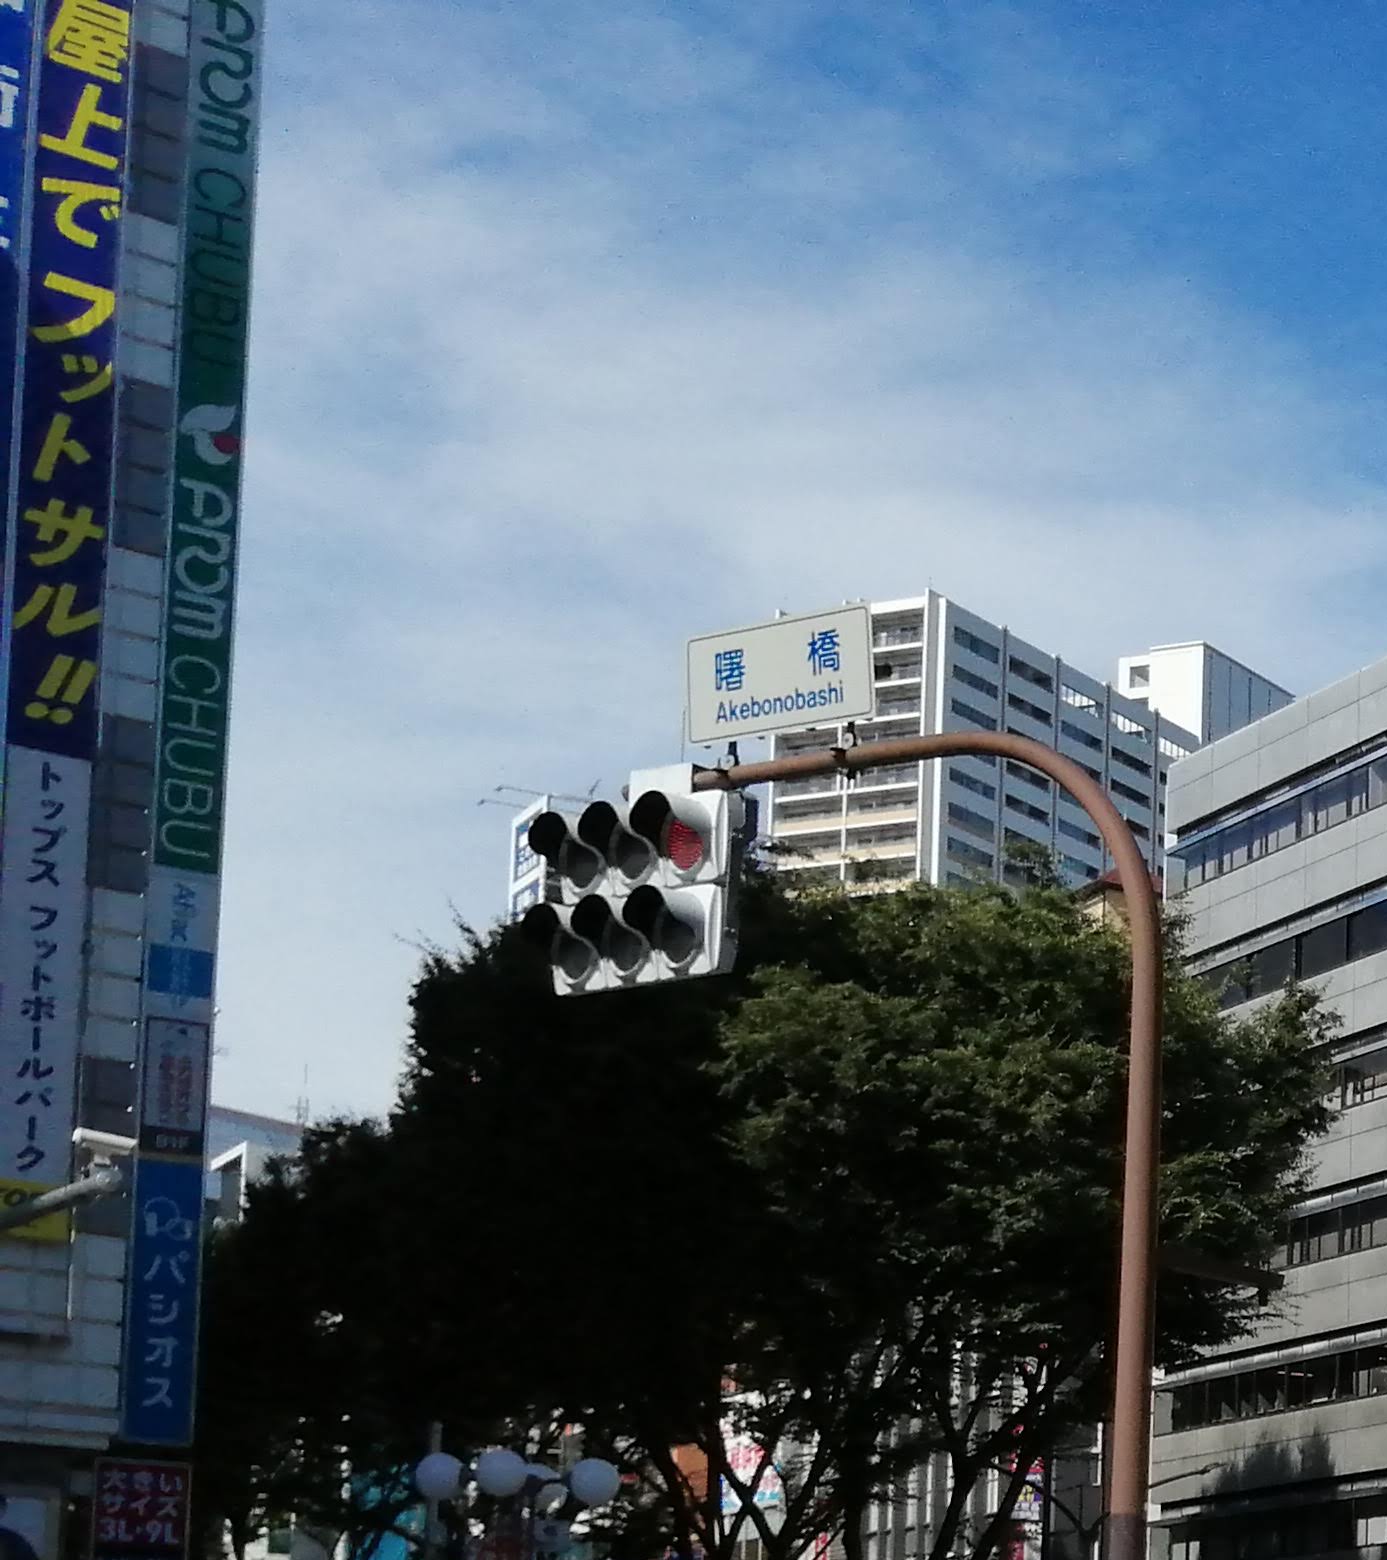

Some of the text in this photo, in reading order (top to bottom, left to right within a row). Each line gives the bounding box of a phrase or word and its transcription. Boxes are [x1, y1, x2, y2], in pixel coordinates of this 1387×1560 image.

[714, 628, 840, 692] 曙橋
[716, 680, 845, 724] Akebonobashi
[159, 653, 222, 862] CHUBU
[27, 762, 68, 888] トップス
[15, 905, 58, 1173] フットボールパーク
[142, 1248, 192, 1409] パシオス
[102, 1470, 183, 1492] 大きい
[102, 1494, 179, 1518] サイズ
